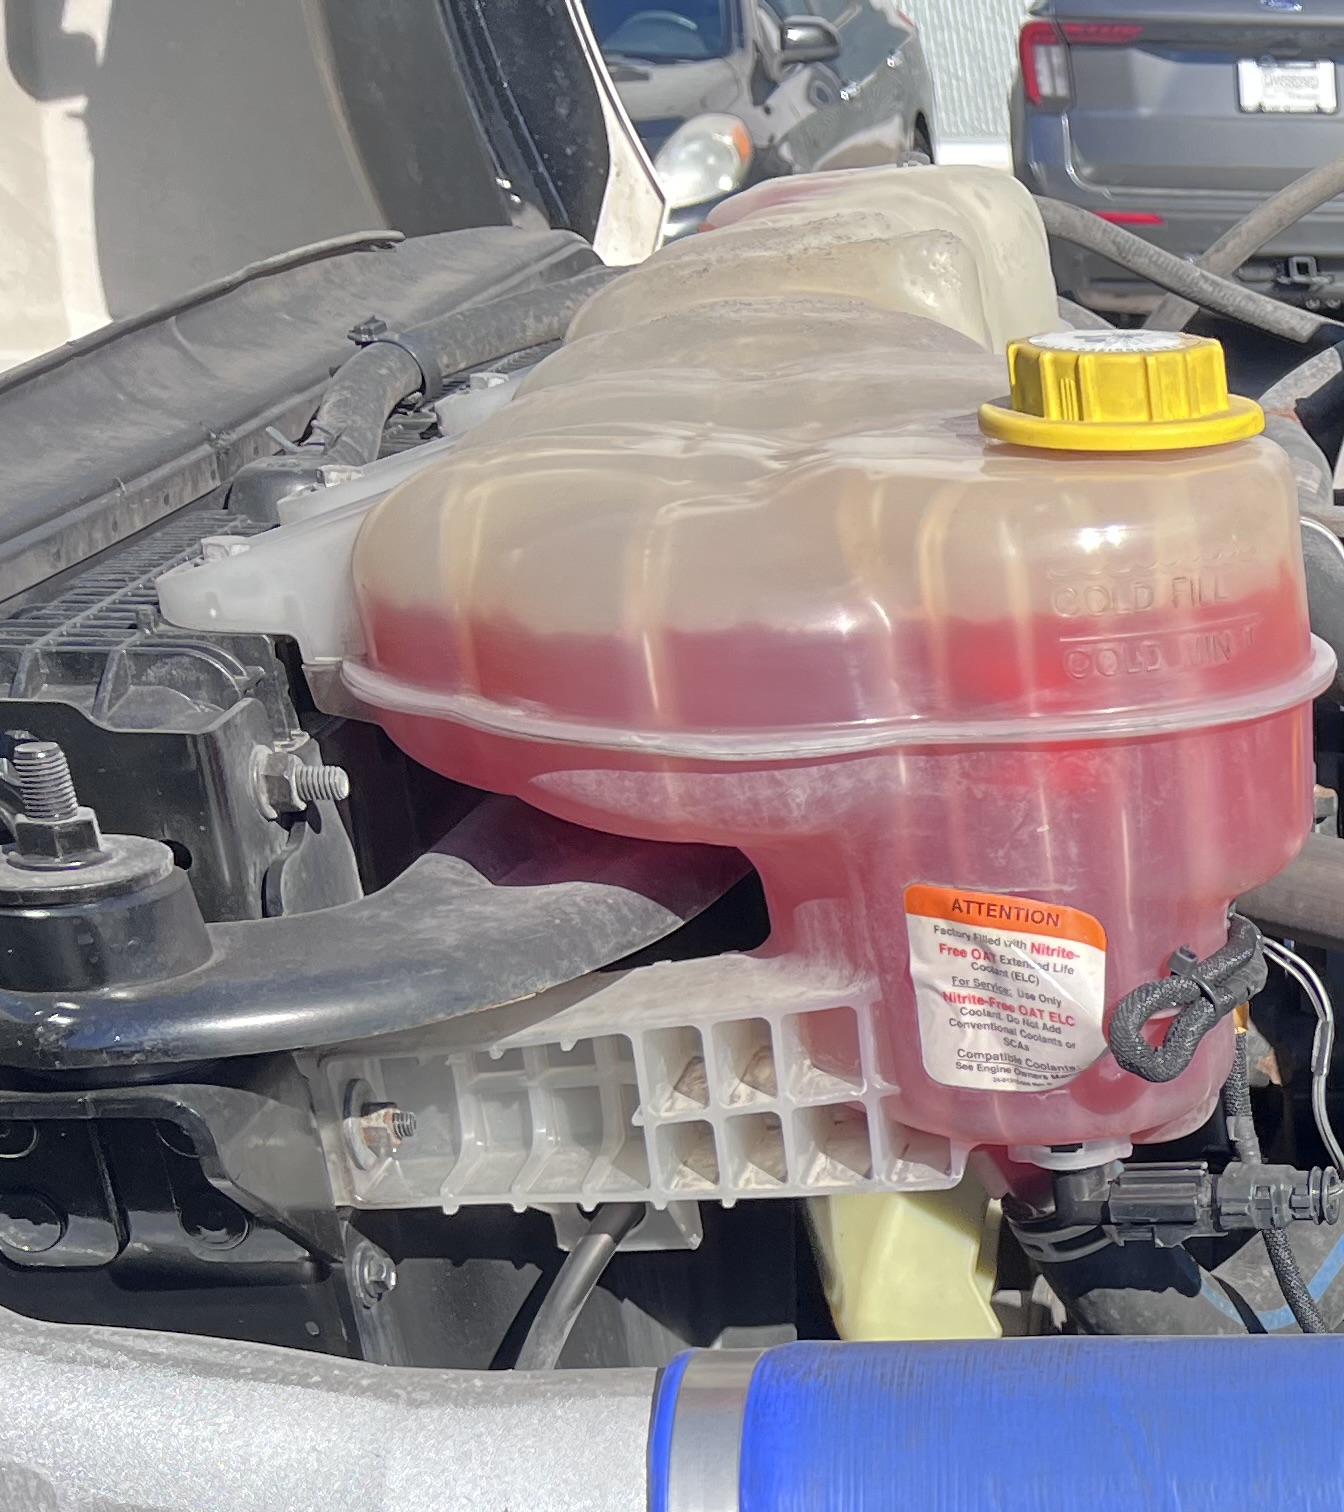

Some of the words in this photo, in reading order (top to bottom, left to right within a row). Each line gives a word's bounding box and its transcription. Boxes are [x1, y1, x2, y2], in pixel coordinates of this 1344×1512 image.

[1054, 581, 1155, 617] COLD
[1172, 576, 1228, 608] FILL
[1065, 642, 1161, 679] COLD
[952, 899, 1060, 927] ATTENTION
[933, 925, 971, 942] Factory
[974, 932, 1000, 947] Filled
[1003, 937, 1027, 950] with
[1031, 942, 1080, 960] Nitrite-
[939, 943, 968, 958] Free
[971, 948, 996, 963] OAT
[1000, 956, 1050, 972] Extended
[1053, 963, 1074, 975] Life
[970, 961, 1009, 978] Coolant
[1011, 971, 1040, 986] (ELC)
[952, 976, 970, 987] For
[973, 979, 1012, 997] Service:
[1017, 989, 1036, 1001] Use
[1039, 993, 1062, 1008] Only
[942, 991, 1016, 1013] Nitrite-Free
[1018, 1005, 1045, 1020] OAT
[1050, 1012, 1075, 1027] ELC
[1006, 1014, 1020, 1026] Do
[1023, 1018, 1039, 1031] Not
[1042, 1021, 1062, 1035] Add
[949, 1018, 1017, 1037] Conventional
[1020, 1028, 1063, 1047] Coolants
[1066, 1040, 1076, 1050] or
[1003, 1037, 1030, 1052] SCAs
[955, 1062, 974, 1073] See
[976, 1063, 1011, 1076] Engine
[957, 1048, 1023, 1067] Compatible
